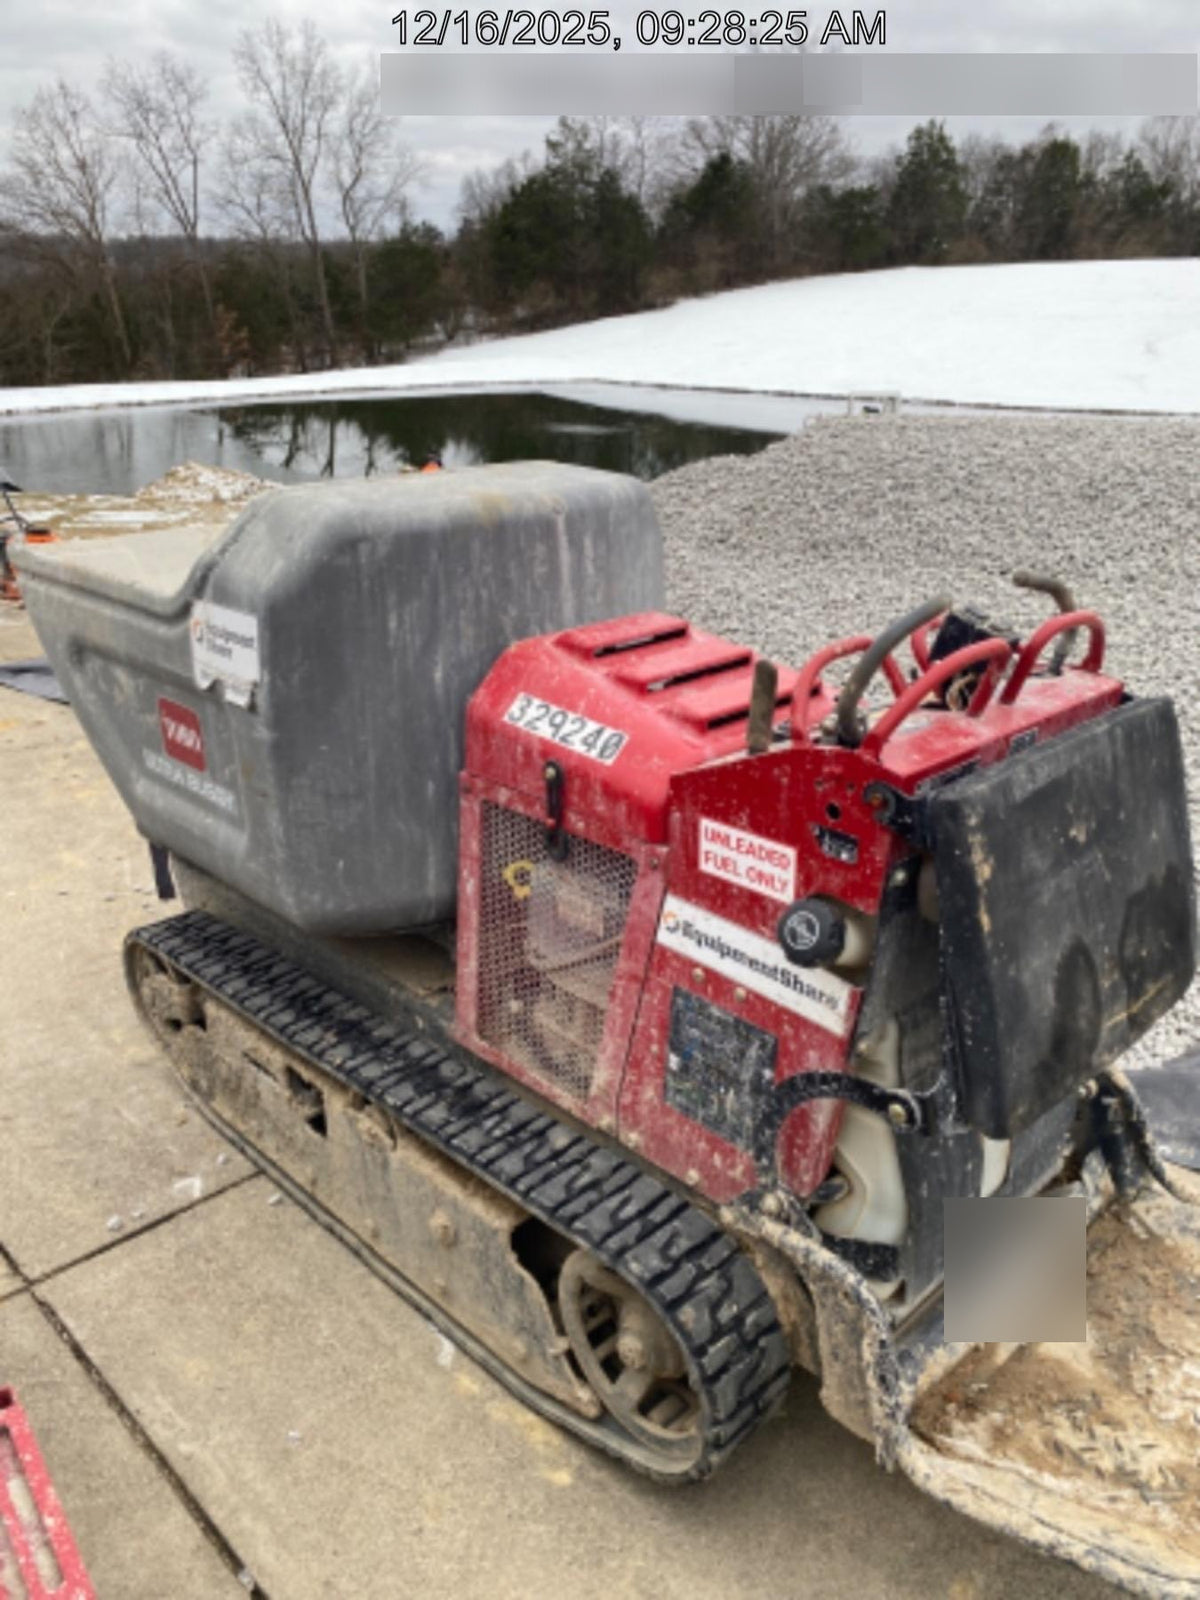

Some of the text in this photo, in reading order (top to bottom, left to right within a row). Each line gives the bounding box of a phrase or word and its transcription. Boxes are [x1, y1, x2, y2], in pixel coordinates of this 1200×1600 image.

[704, 825, 791, 871] UNLEADED
[703, 850, 789, 894] FUEL ONLY
[681, 919, 840, 1012] EquipmentShare
